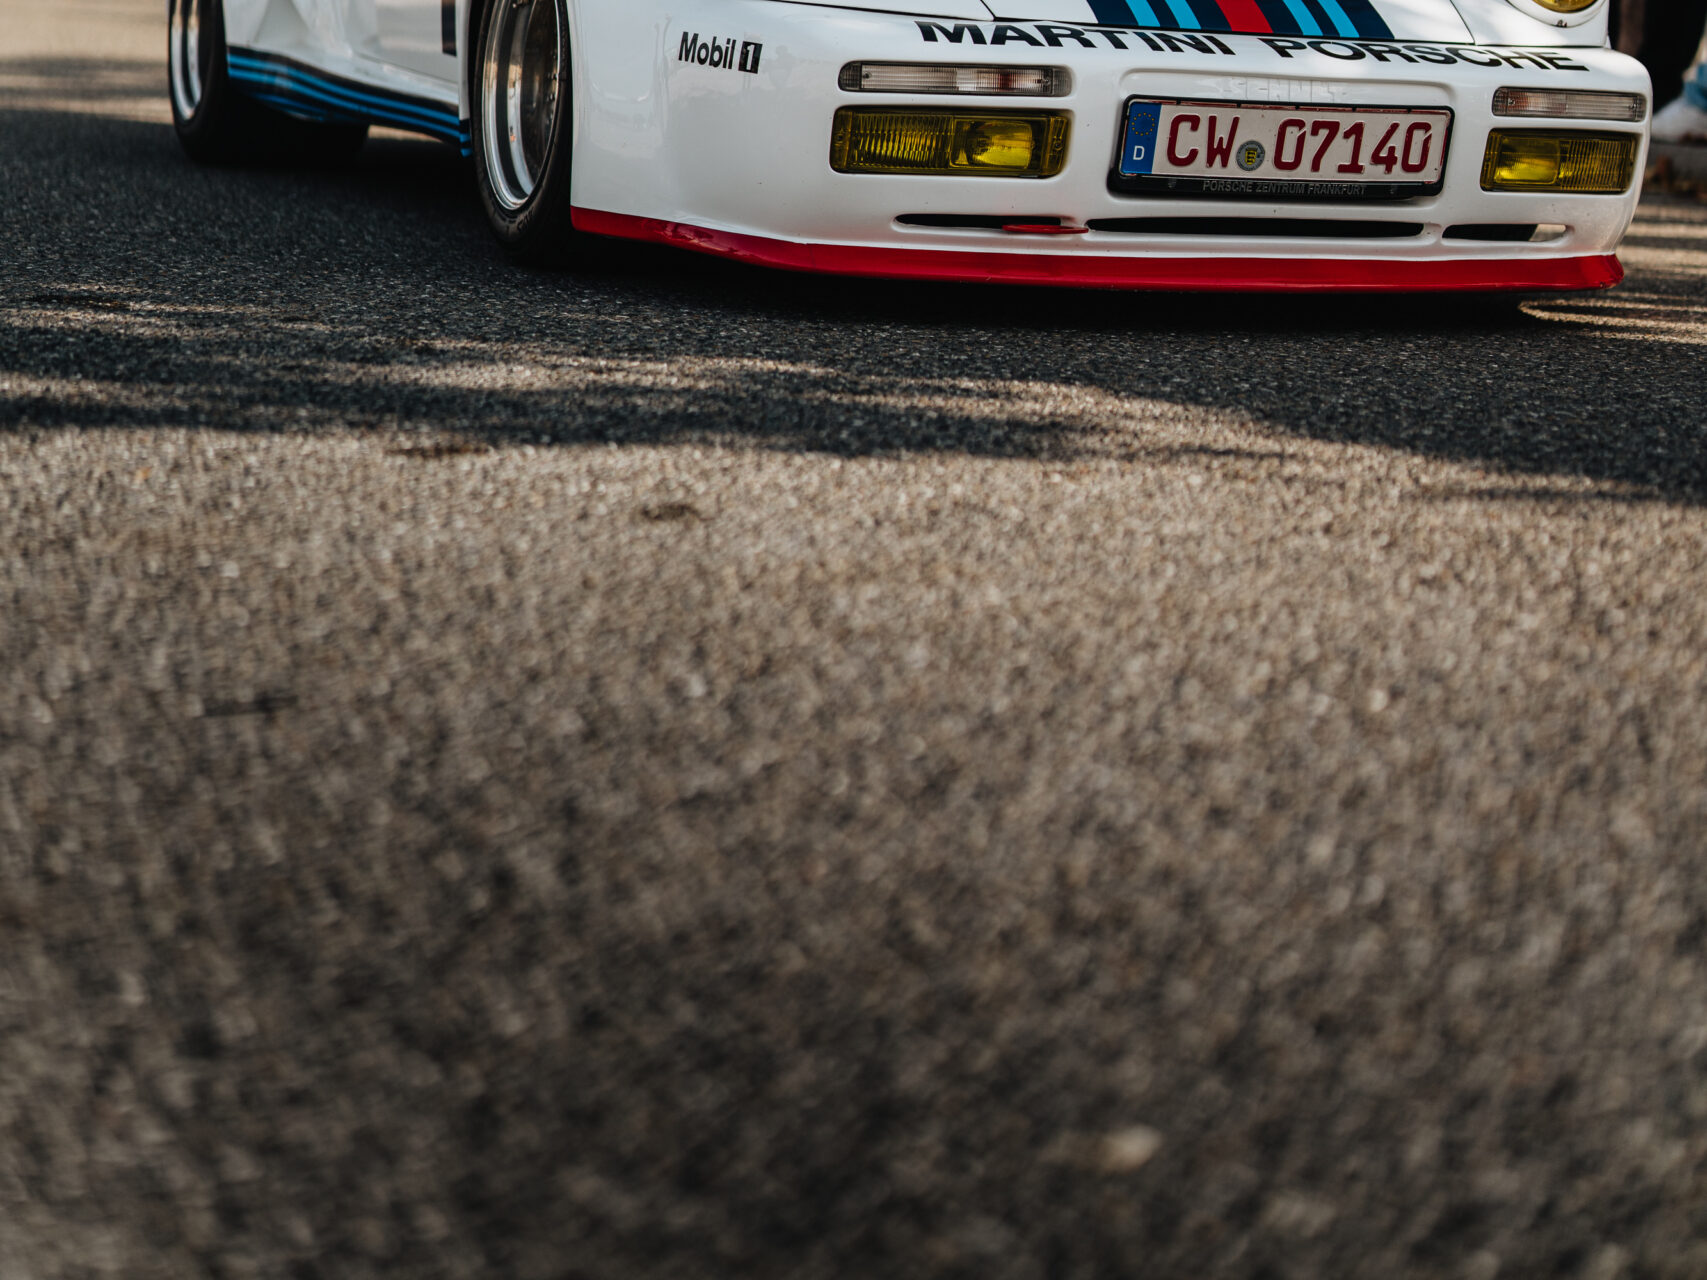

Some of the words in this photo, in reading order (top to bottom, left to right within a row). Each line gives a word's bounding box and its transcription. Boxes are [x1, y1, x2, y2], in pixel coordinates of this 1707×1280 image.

[678, 31, 737, 70] Mobil
[914, 20, 1237, 57] MARTINI
[1257, 37, 1591, 73] PORSCHE
[1132, 145, 1145, 161] D
[1166, 113, 1240, 169] CW
[1273, 117, 1433, 175] 07140
[1202, 179, 1253, 193] PORSCHE
[1255, 182, 1305, 195] ZENTRUM
[1307, 183, 1367, 196] FRANKFURT
